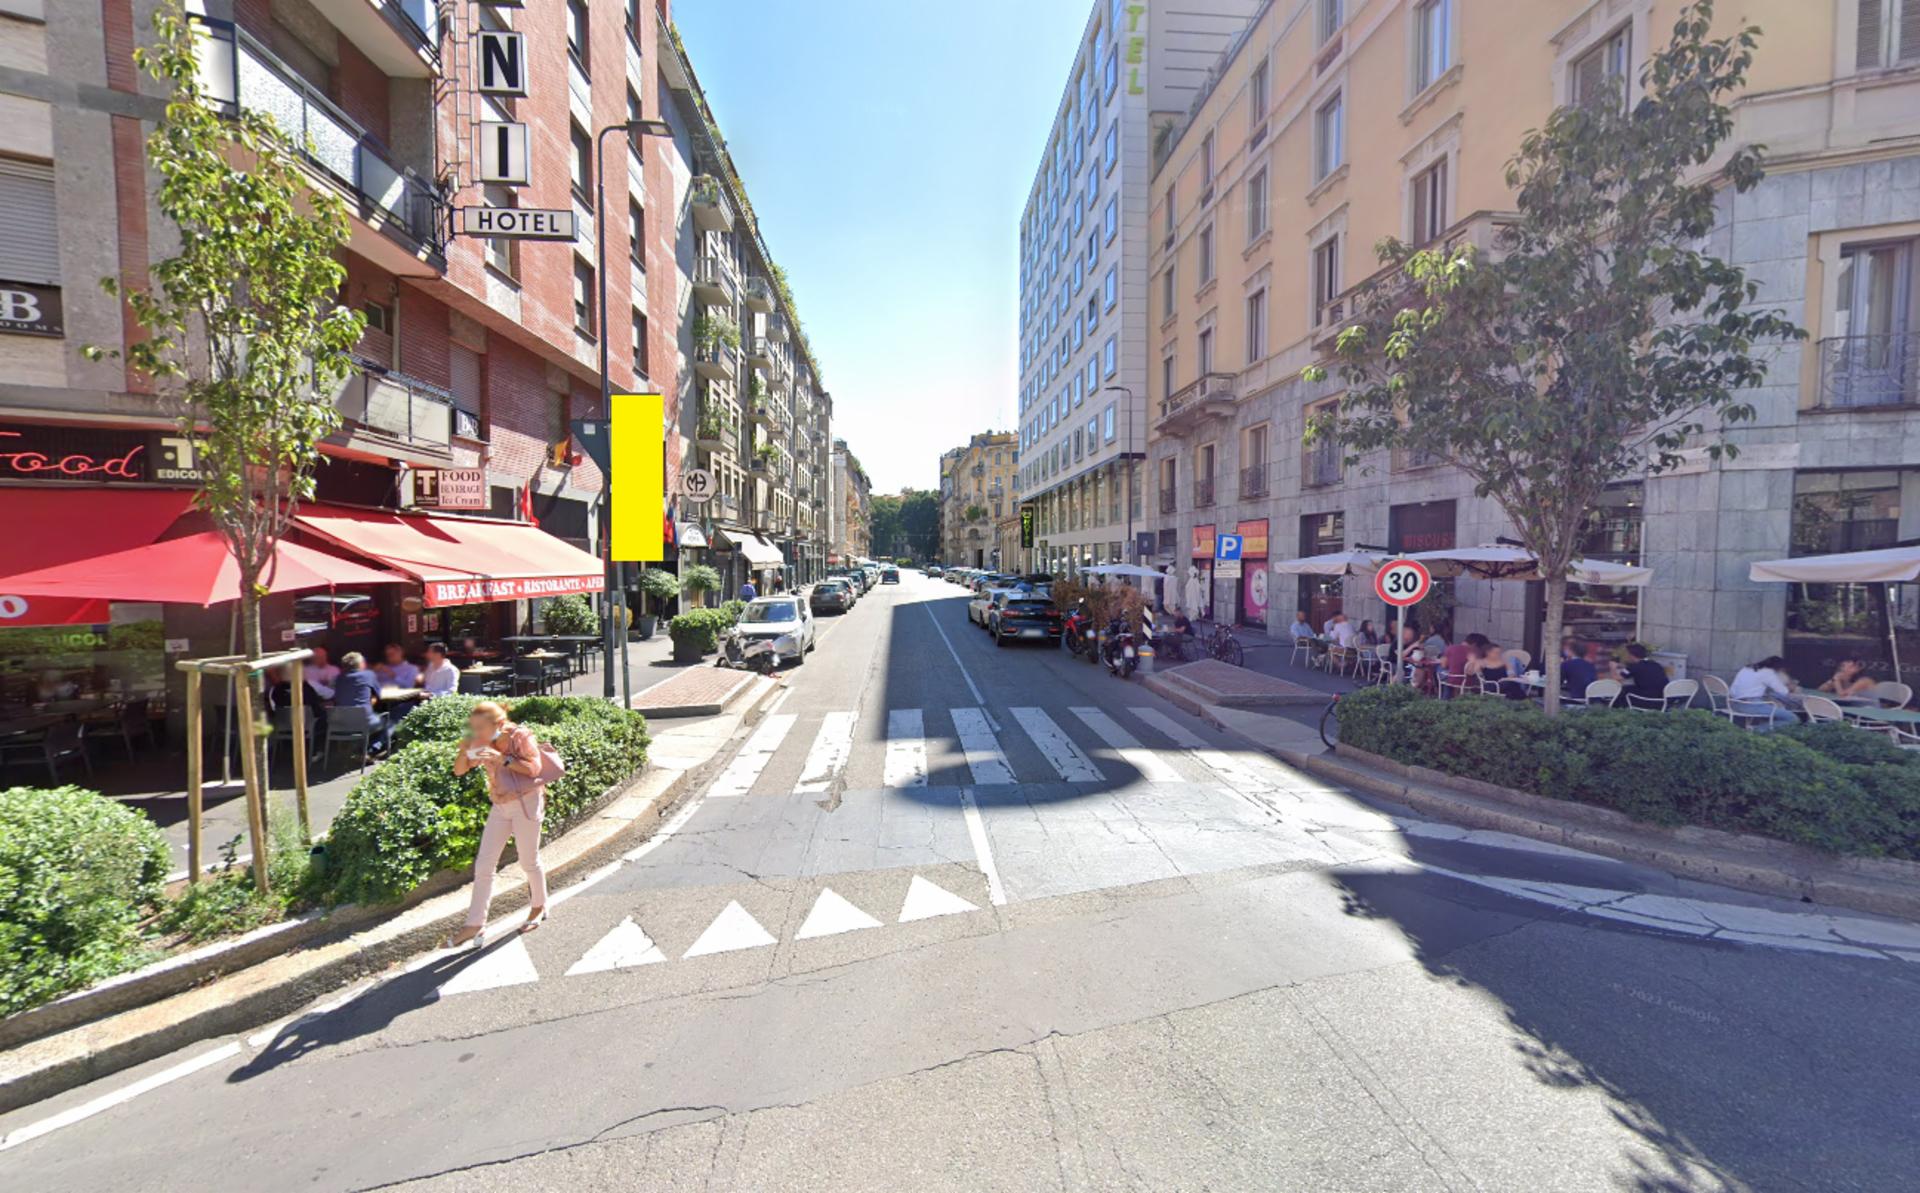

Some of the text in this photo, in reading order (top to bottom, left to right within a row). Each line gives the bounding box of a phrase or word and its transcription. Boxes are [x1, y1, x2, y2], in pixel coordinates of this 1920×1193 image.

[1126, 0, 1145, 95] TEL
[478, 210, 561, 234] HOTEL
[417, 470, 437, 495] T
[441, 471, 481, 482] FOOD
[440, 484, 481, 494] BEVERAGE
[441, 495, 453, 504] Ice
[454, 496, 481, 505] Cream
[1220, 536, 1238, 558] P
[436, 580, 516, 601] BREAKFAST
[523, 578, 580, 594] RISTORANTE
[1387, 571, 1418, 594] 30
